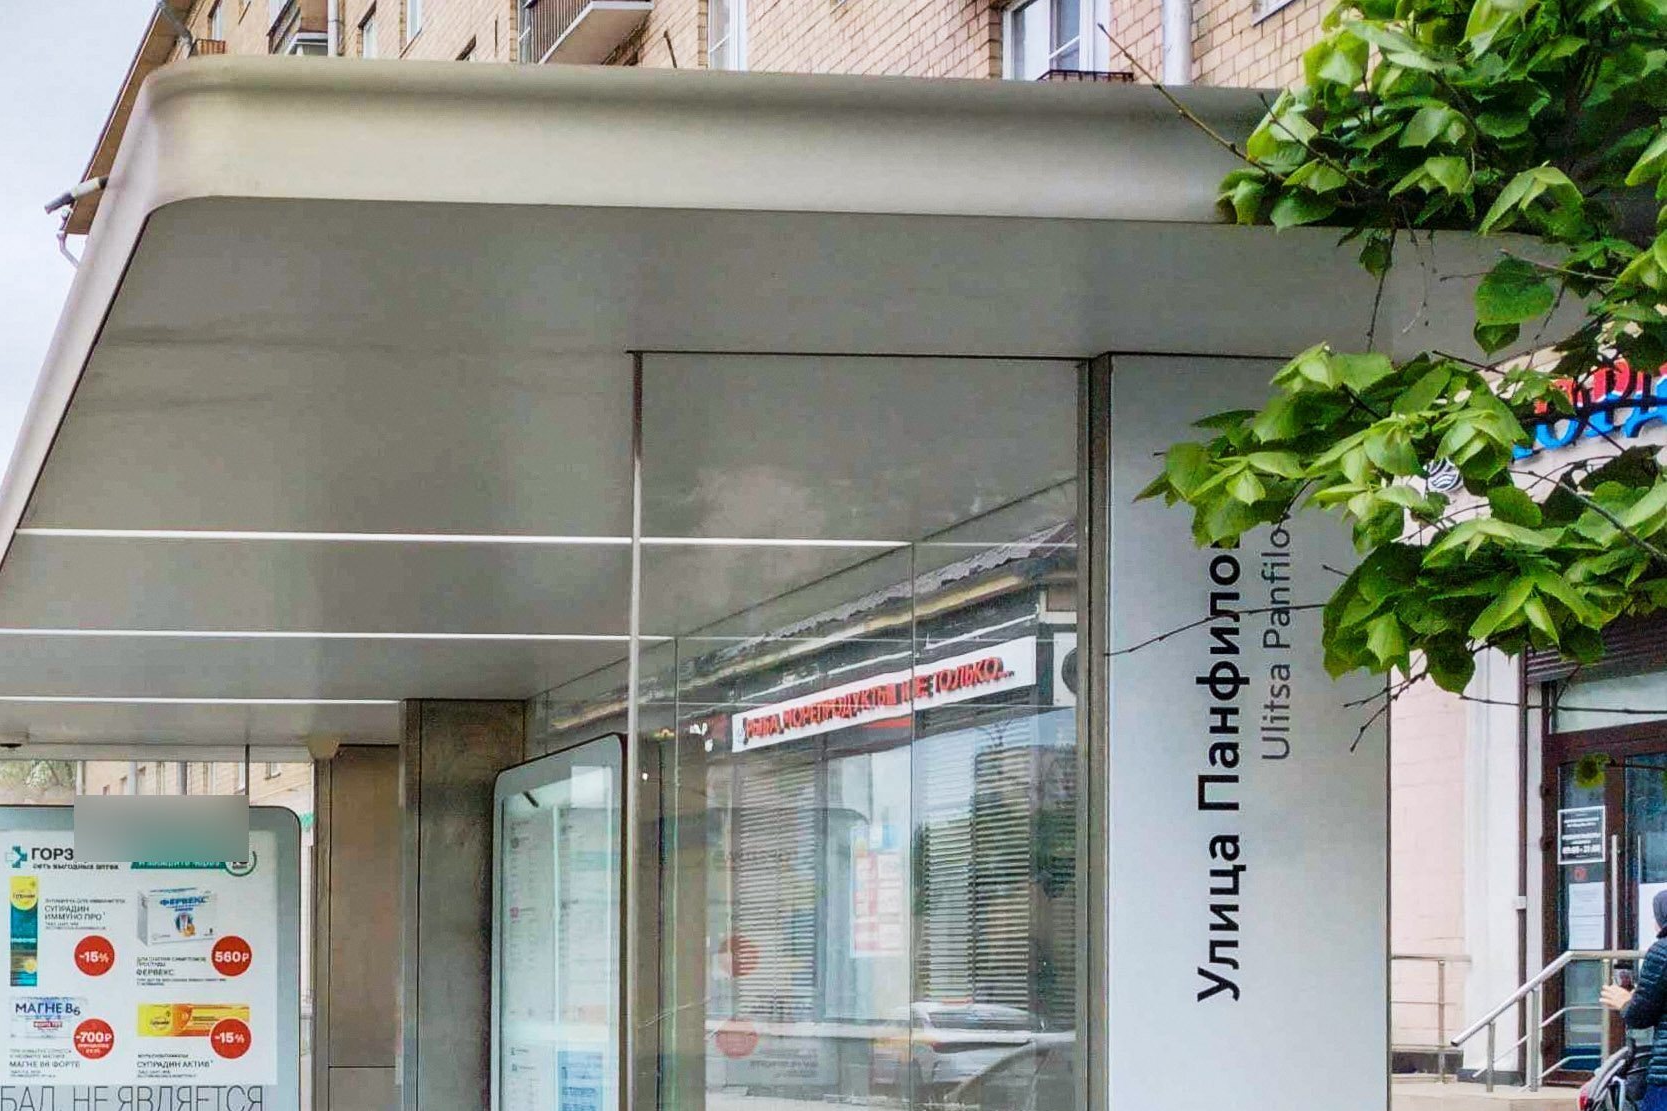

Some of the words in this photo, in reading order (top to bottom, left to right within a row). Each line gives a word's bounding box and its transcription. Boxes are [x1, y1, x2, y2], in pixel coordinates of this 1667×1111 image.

[1261, 513, 1291, 649] Panfilo
[1196, 538, 1250, 811] Панфило
[1261, 664, 1291, 760] Ulitsa
[31, 848, 74, 860] ГОРЗ
[1196, 834, 1247, 1002] Улица
[15, 1002, 62, 1013] МАГНЕ
